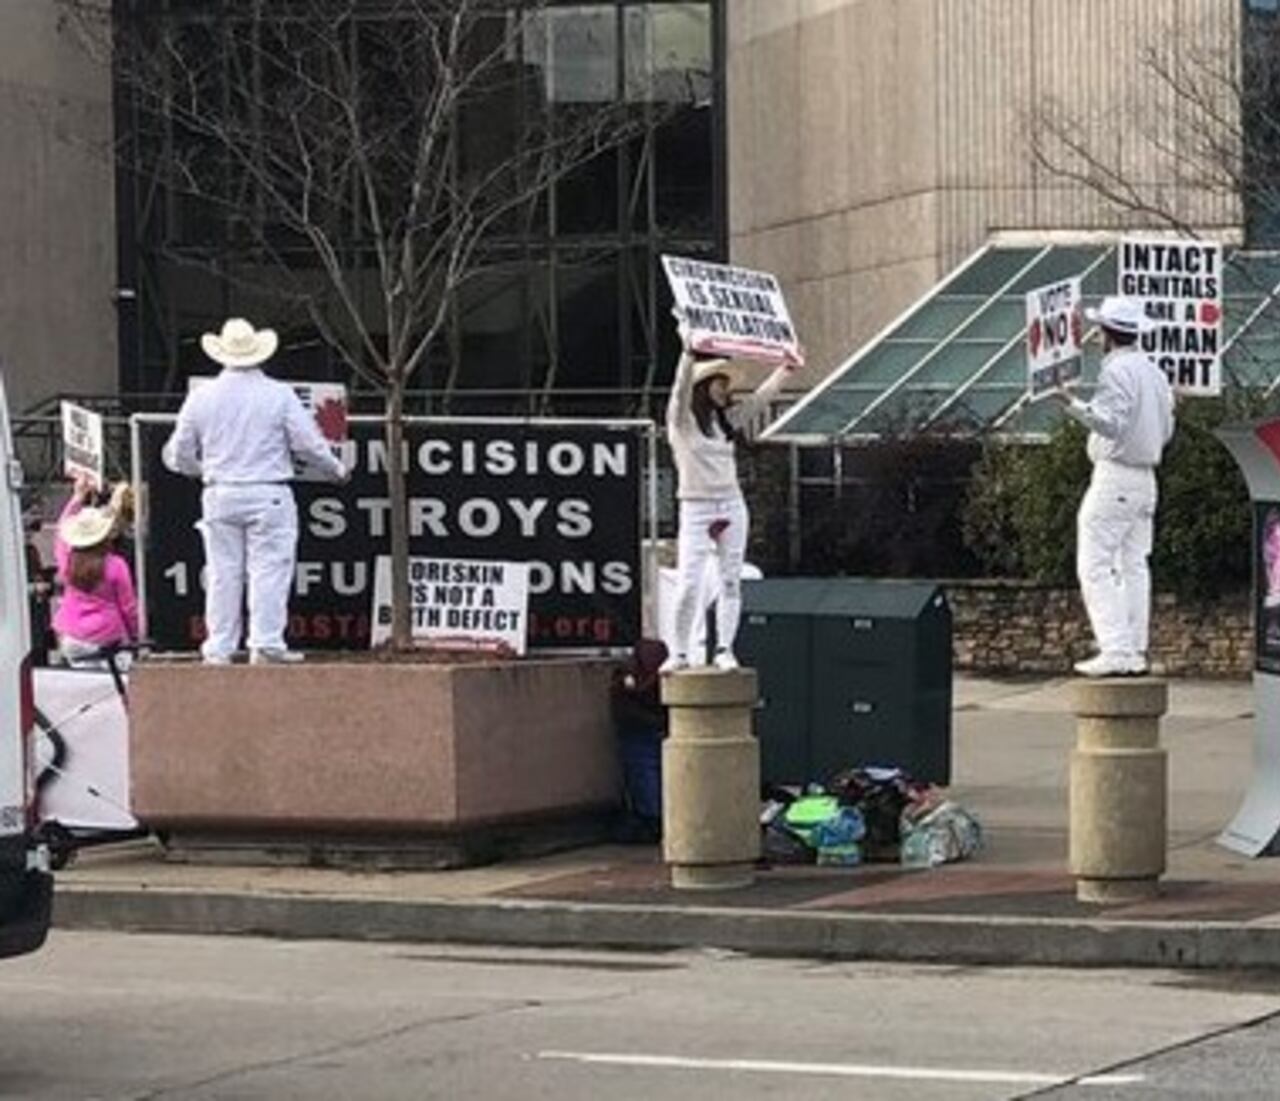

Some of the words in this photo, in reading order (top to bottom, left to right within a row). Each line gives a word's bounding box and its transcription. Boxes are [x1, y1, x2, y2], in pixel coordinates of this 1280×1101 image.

[1123, 244, 1217, 274] INTACT
[685, 281, 708, 306] IS
[708, 285, 777, 318] SEXUAL
[1122, 274, 1217, 299] GENITALS
[1144, 301, 1176, 321] ARE
[1184, 303, 1197, 321] A
[685, 306, 793, 344] MUTILATION
[1043, 312, 1068, 352] NO
[1141, 326, 1217, 354] UMAN
[411, 561, 504, 584] ORESKIN
[434, 585, 475, 607] NOT
[482, 588, 495, 607] A
[447, 608, 520, 631] DEFECT
